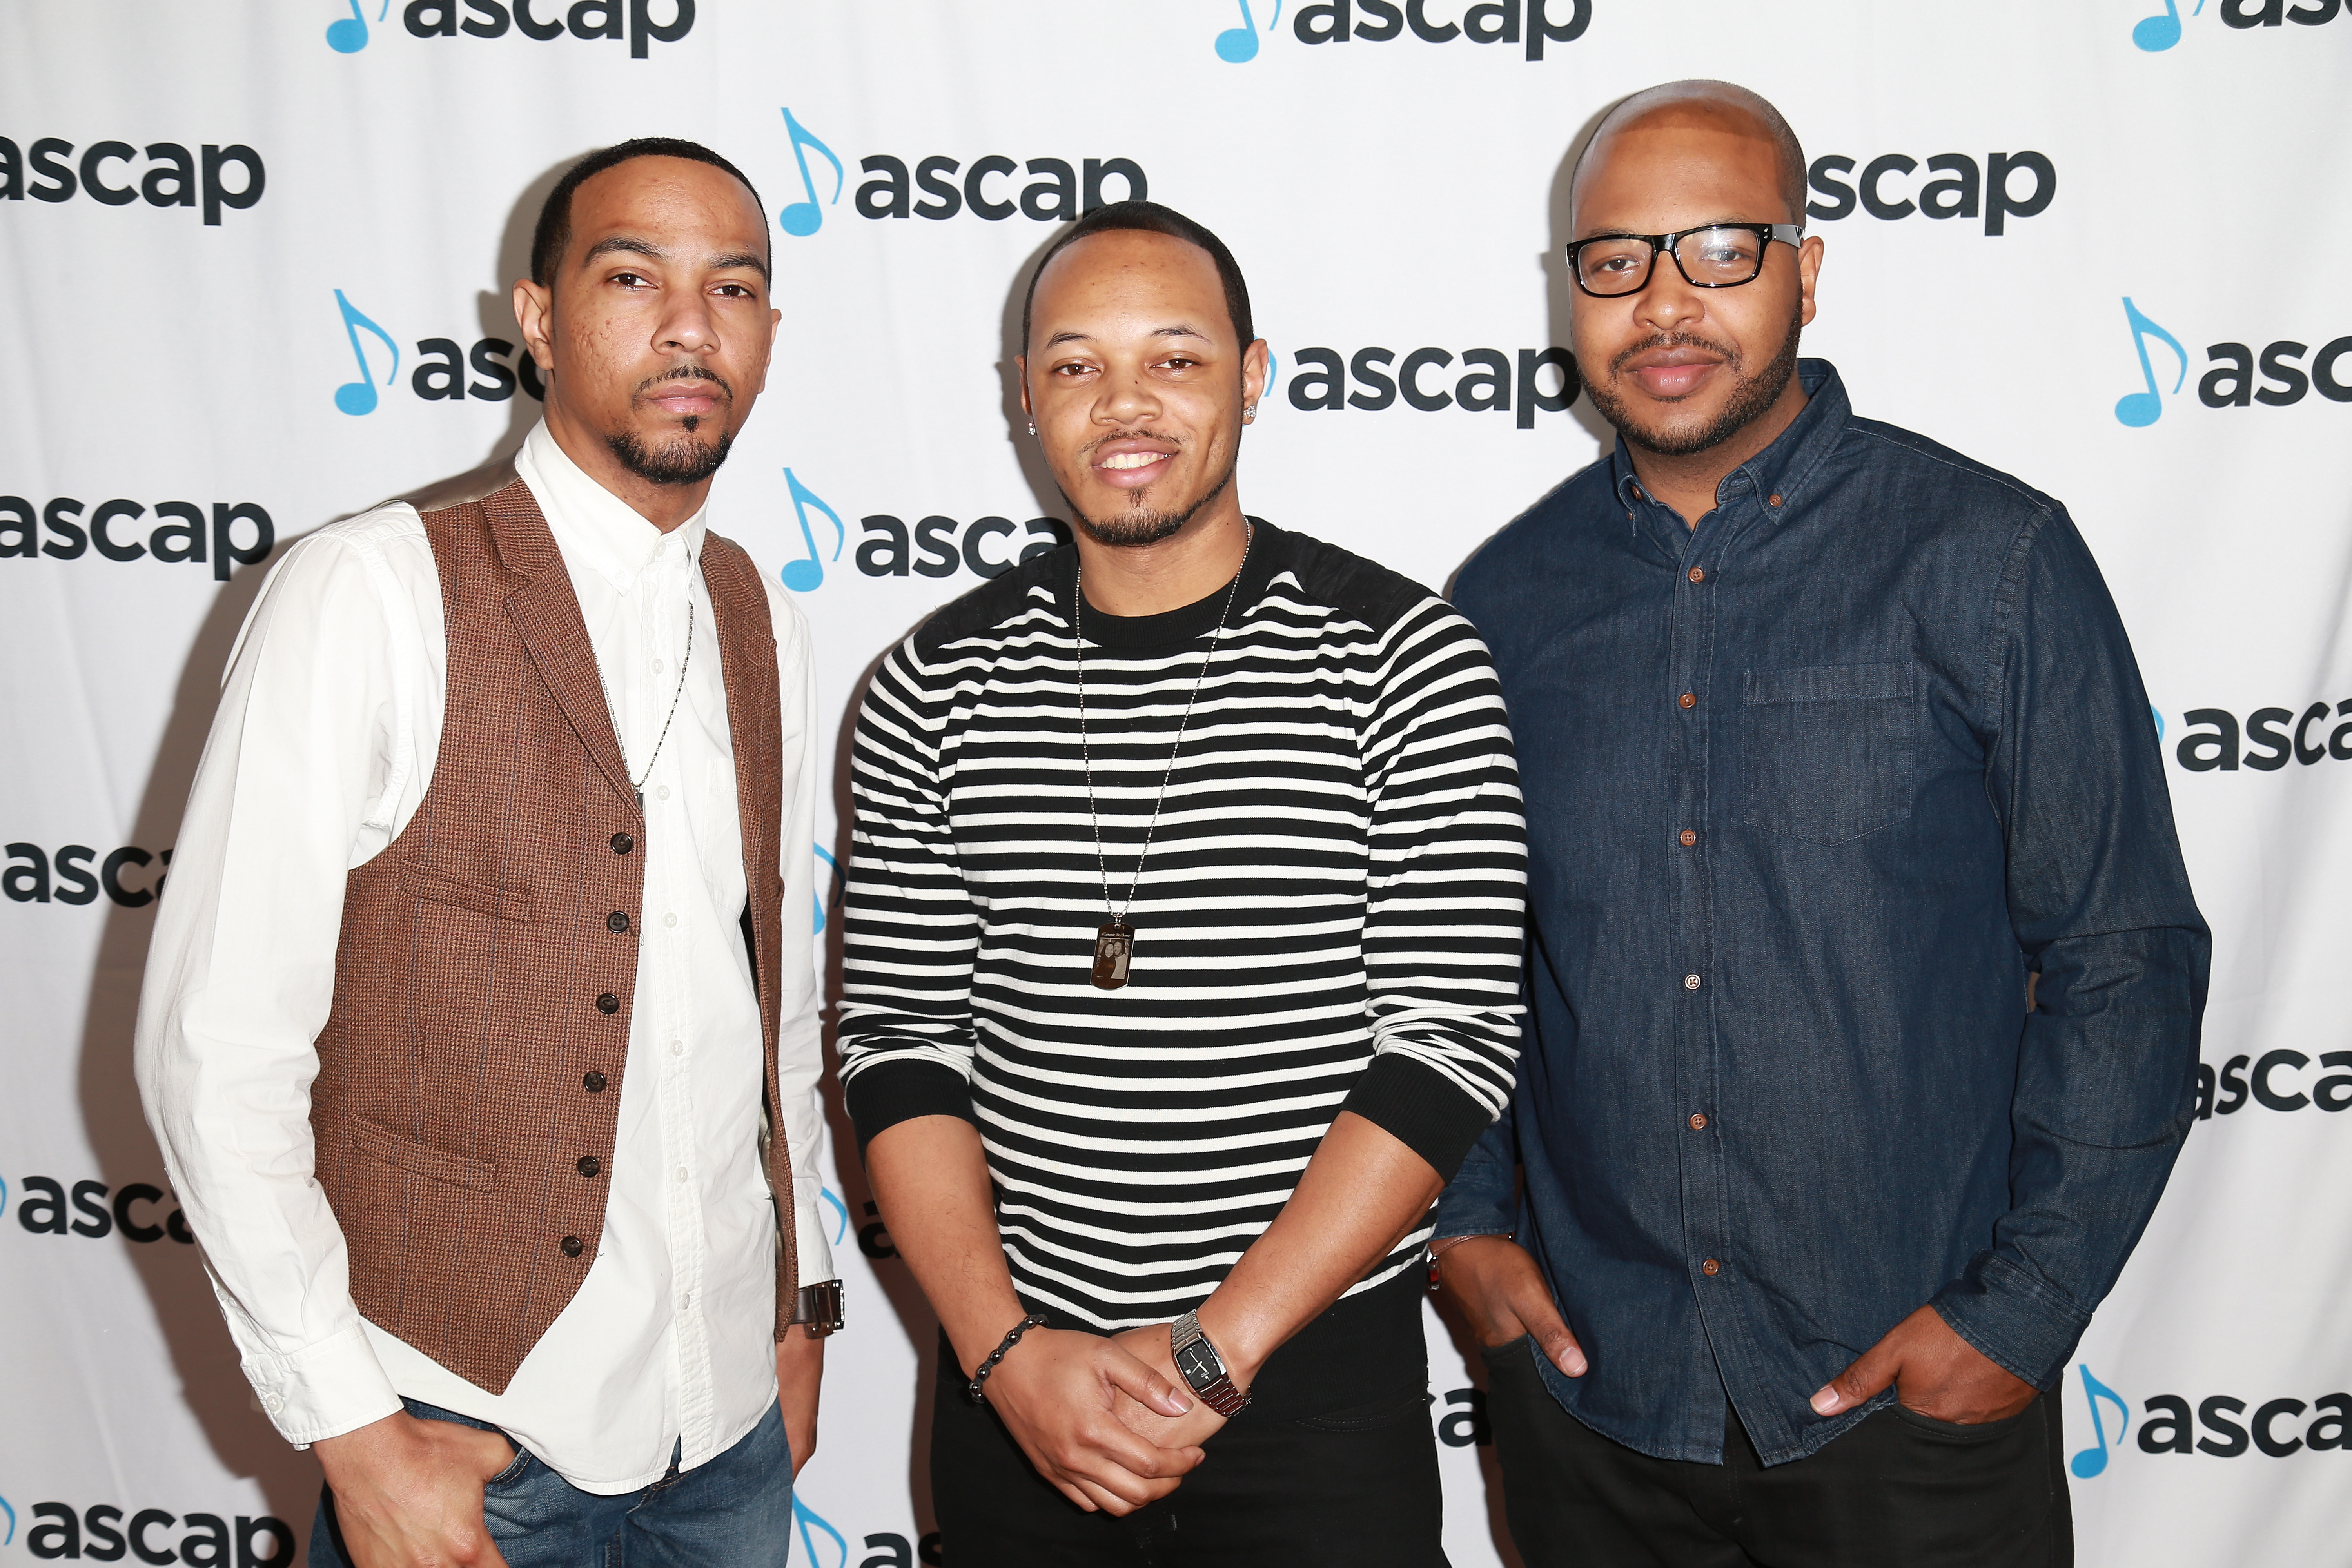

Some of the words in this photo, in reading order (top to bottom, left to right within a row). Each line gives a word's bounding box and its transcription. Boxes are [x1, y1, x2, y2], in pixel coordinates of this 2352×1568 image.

[404, 0, 695, 59] ascap
[1294, 0, 1592, 61] ascap
[1288, 347, 1581, 429] ascap
[0, 496, 275, 581] ascap
